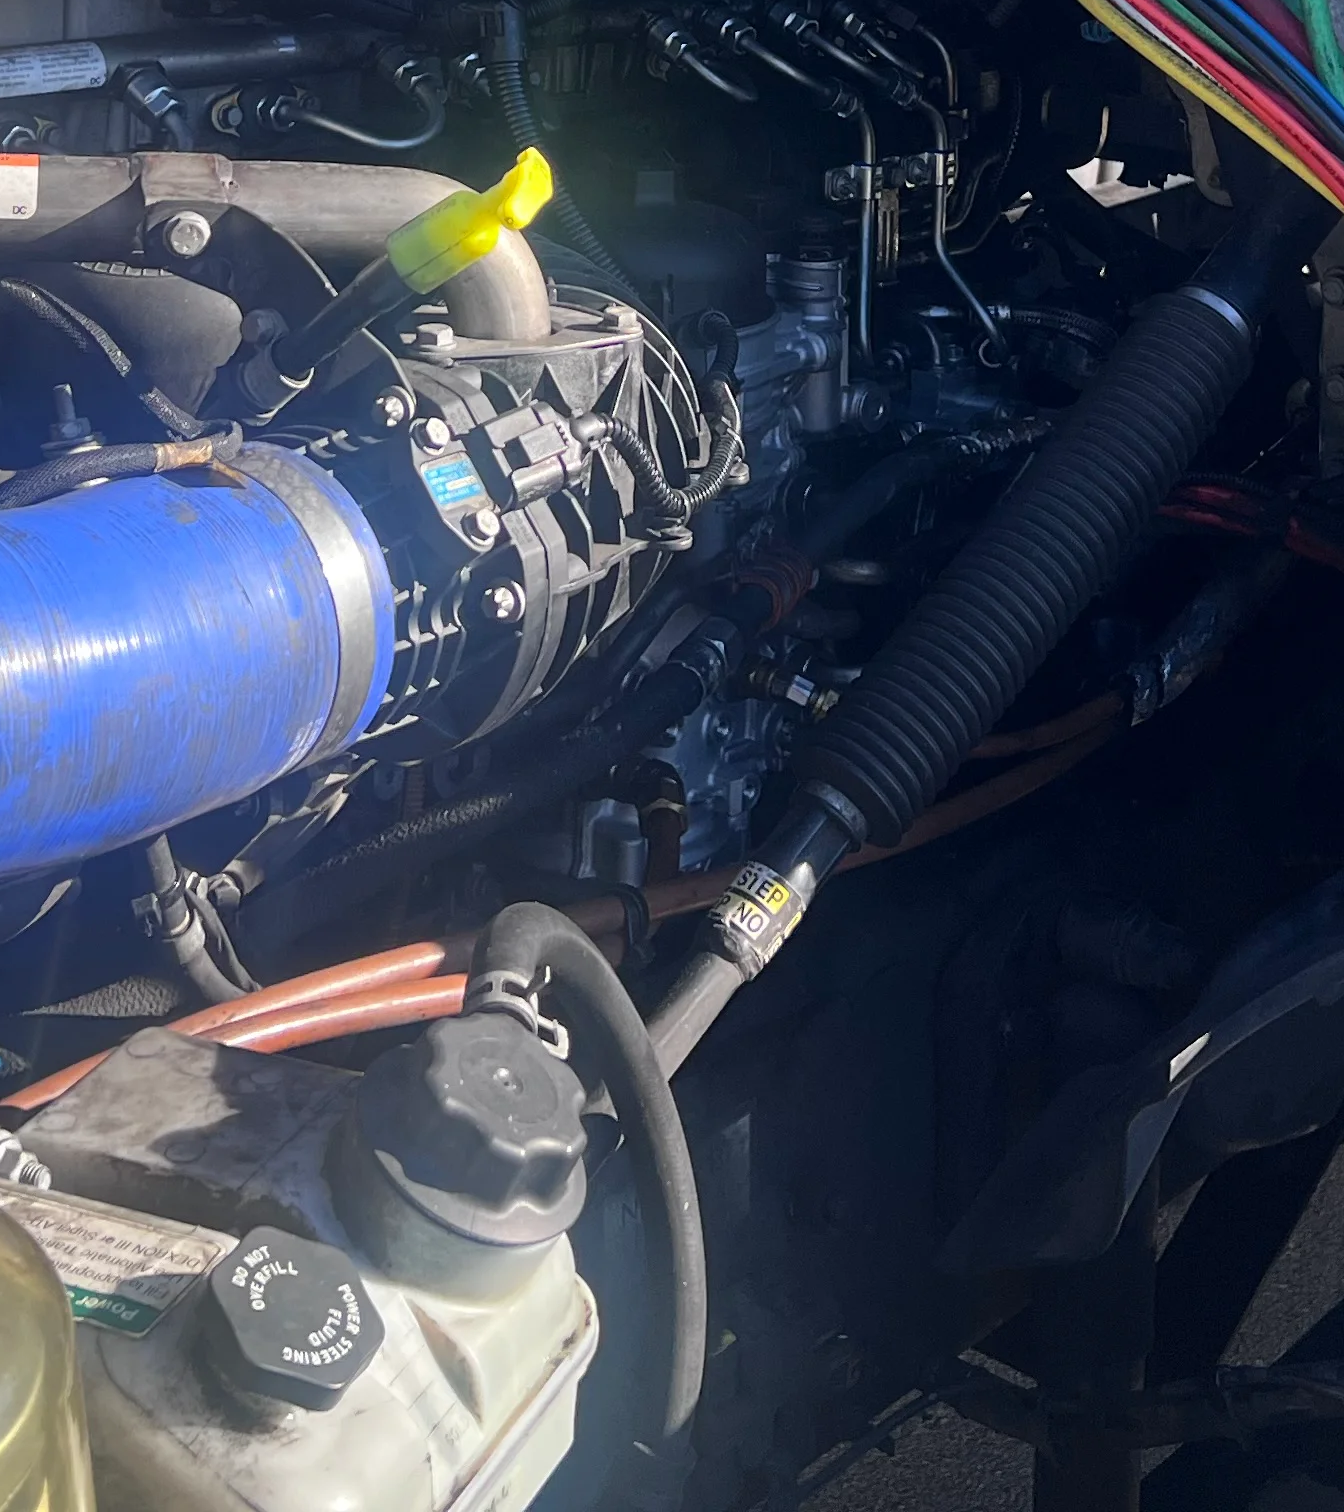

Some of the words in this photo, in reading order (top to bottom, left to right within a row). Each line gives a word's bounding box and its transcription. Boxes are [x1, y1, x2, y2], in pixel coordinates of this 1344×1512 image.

[12, 205, 27, 215] DC
[737, 870, 784, 905] STEP
[733, 901, 765, 933] NO
[56, 1223, 98, 1242] Super
[100, 1235, 115, 1245] or
[114, 1238, 132, 1251] III
[80, 1249, 154, 1274] Automatic
[132, 1243, 201, 1269] DEXRON
[231, 1266, 248, 1287] DO
[243, 1245, 270, 1268] NOT
[249, 1260, 298, 1311] OVERFILL
[75, 1295, 139, 1321] Power
[338, 1283, 361, 1335] POWER
[308, 1308, 342, 1347] FLUID
[282, 1336, 353, 1366] STEERING
